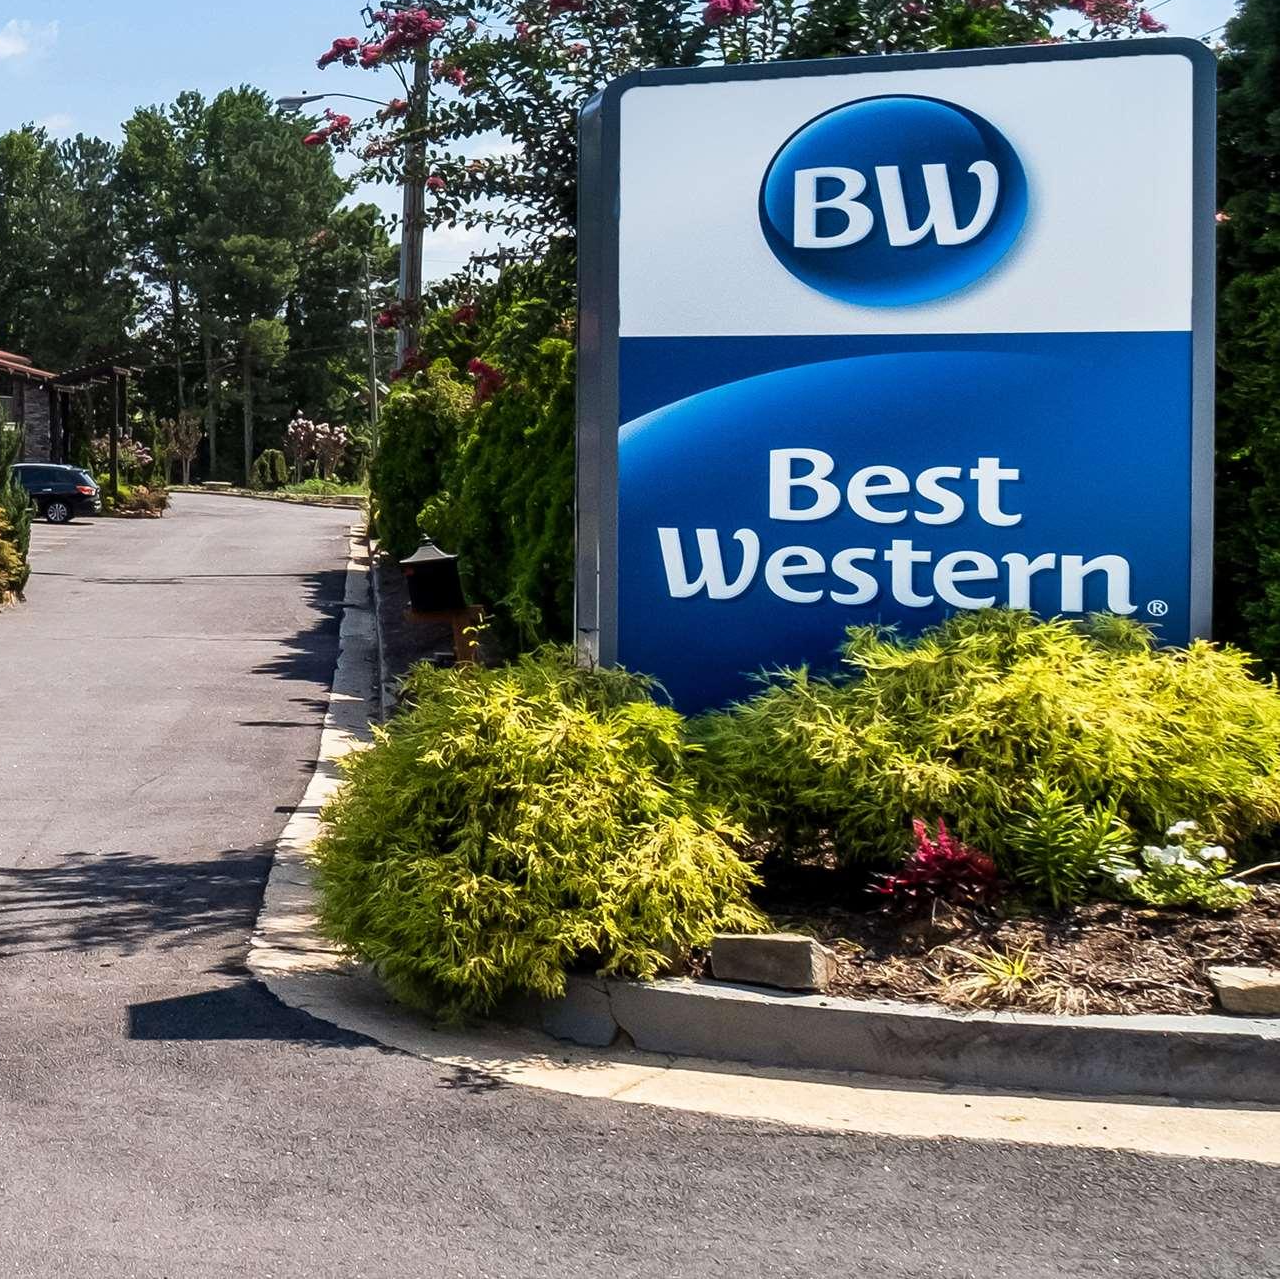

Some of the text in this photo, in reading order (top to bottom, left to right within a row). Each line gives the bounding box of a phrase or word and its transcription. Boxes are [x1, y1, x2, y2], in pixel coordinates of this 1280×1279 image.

[792, 159, 1000, 250] BW
[768, 447, 1023, 528] Best
[656, 526, 1138, 616] Western
